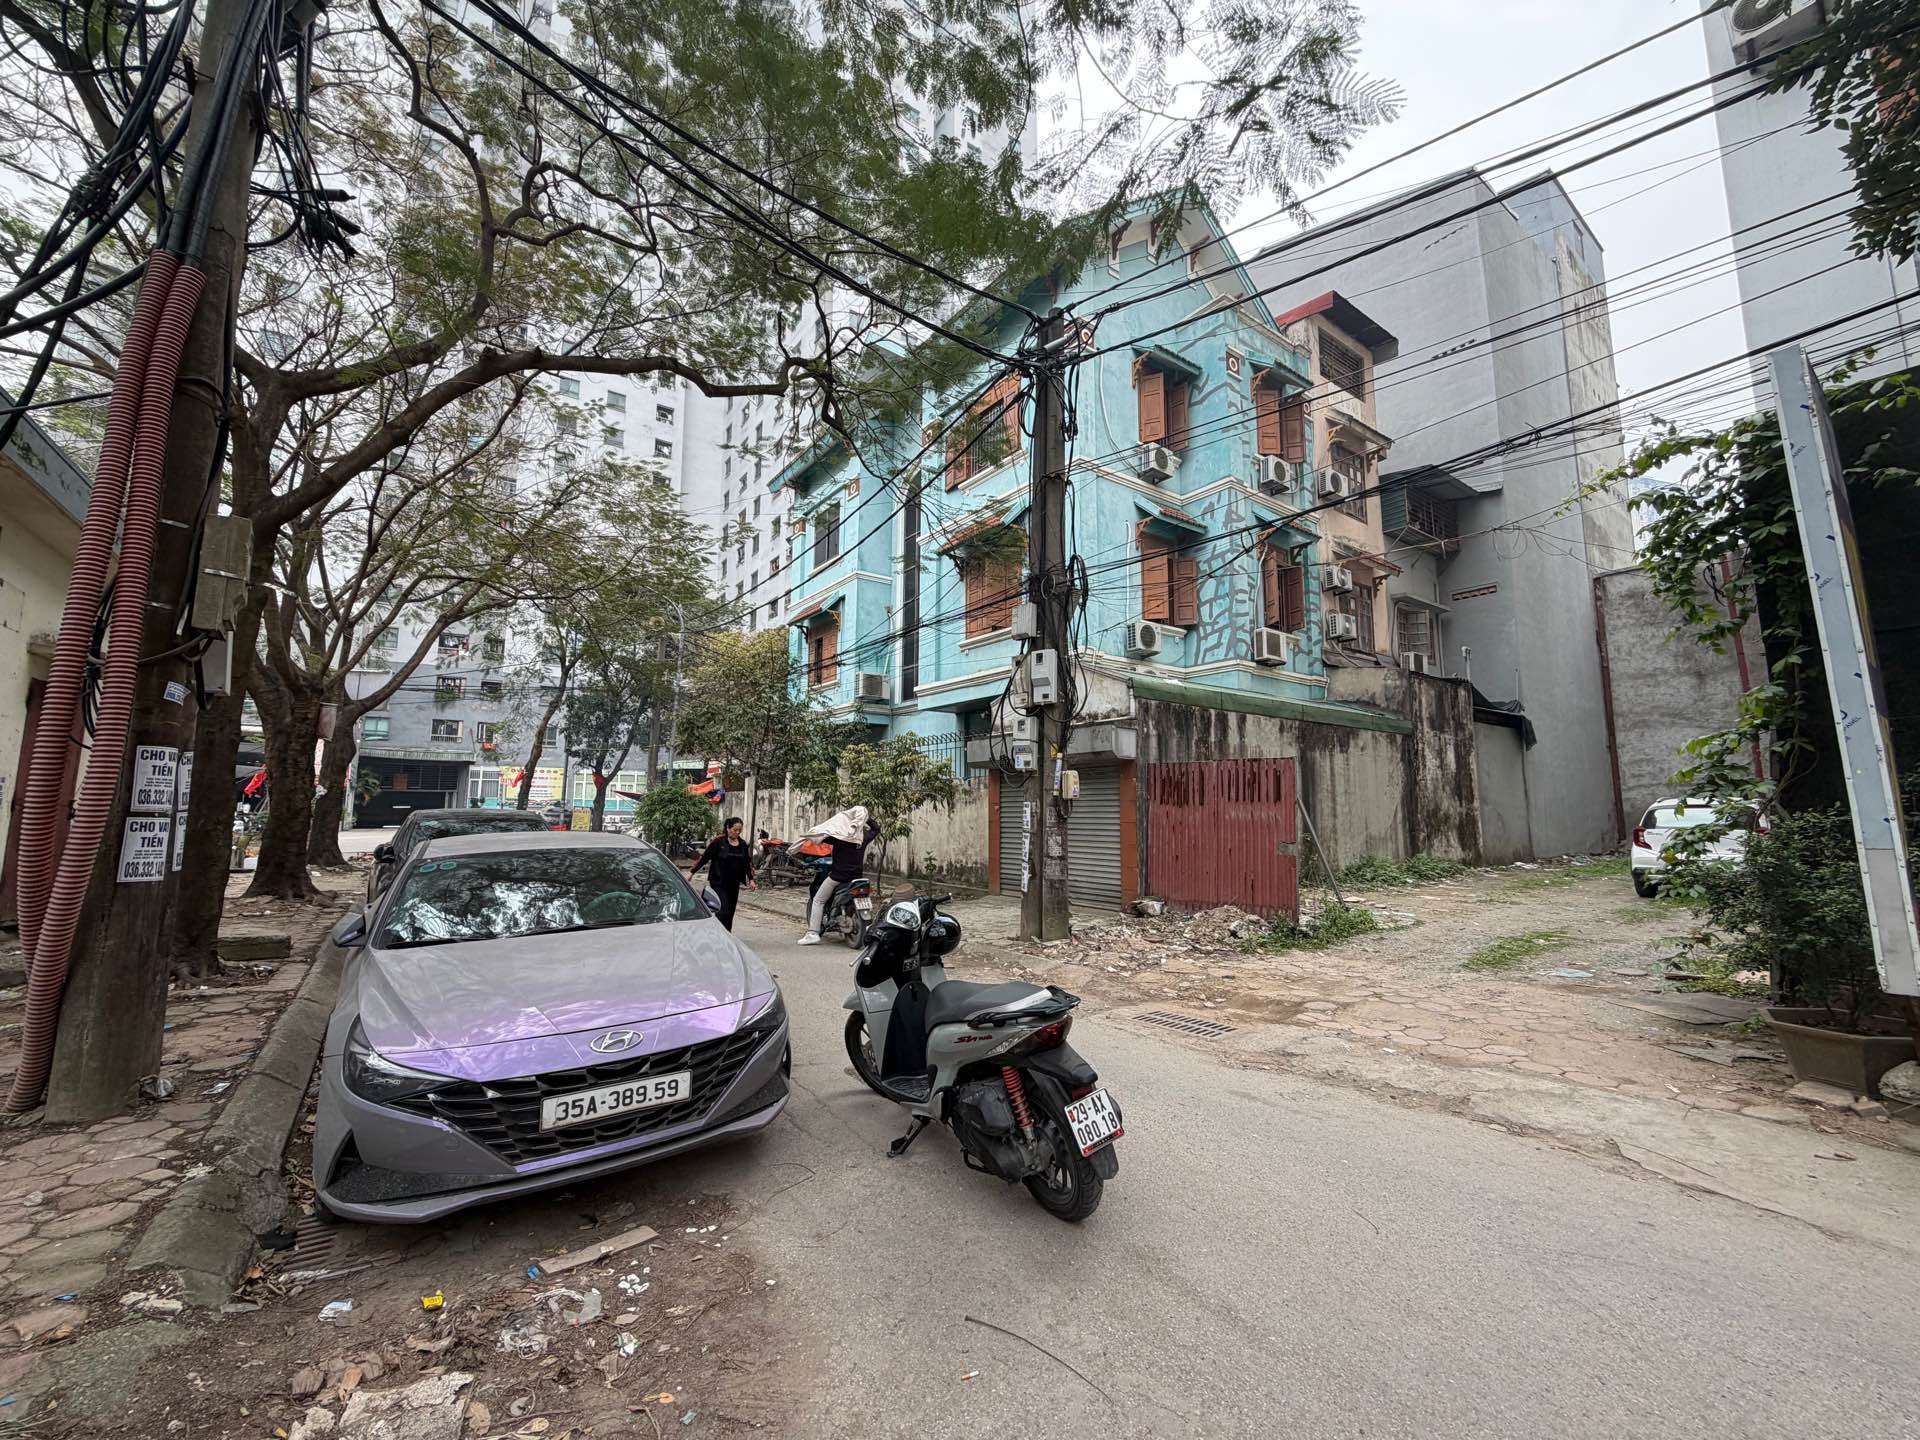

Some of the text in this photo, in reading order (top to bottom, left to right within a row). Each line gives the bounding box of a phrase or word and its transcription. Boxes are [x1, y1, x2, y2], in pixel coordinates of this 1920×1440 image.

[140, 749, 178, 762] CHO VA
[130, 821, 169, 832] CHO VA
[555, 1079, 679, 1121] 35A-389.59
[1077, 1111, 1118, 1146] 080.18
